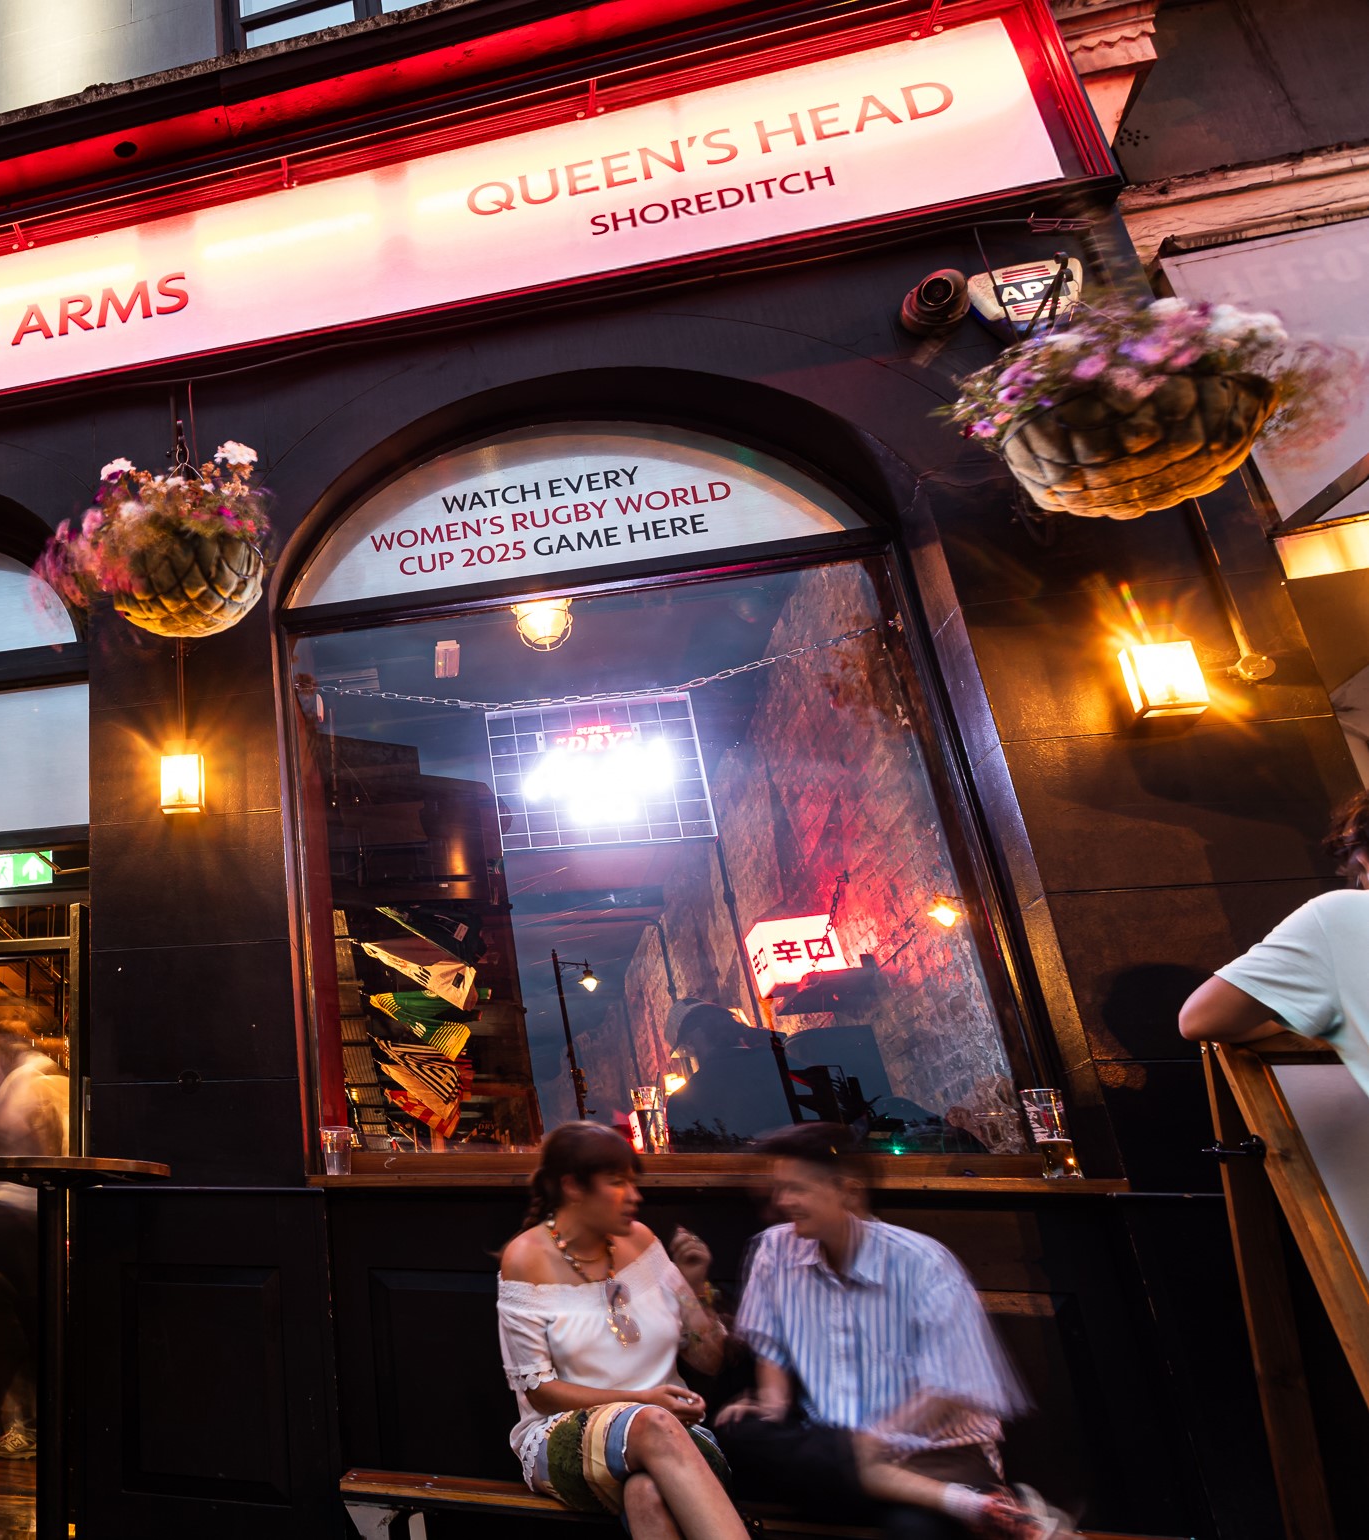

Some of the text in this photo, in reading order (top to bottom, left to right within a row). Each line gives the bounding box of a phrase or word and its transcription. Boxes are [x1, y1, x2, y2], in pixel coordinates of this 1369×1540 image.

[466, 82, 954, 216] QUEEN'S HEAD
[589, 166, 836, 236] SHOREDITCH
[11, 272, 189, 346] ARMS
[370, 481, 732, 552] WOMEN'S RUGBY WORLD
[441, 465, 639, 514] WATCH EVERY
[399, 514, 710, 576] CUP 2025 GAME HERE
[576, 724, 612, 736] SUPER
[772, 937, 835, 963] 辛口
